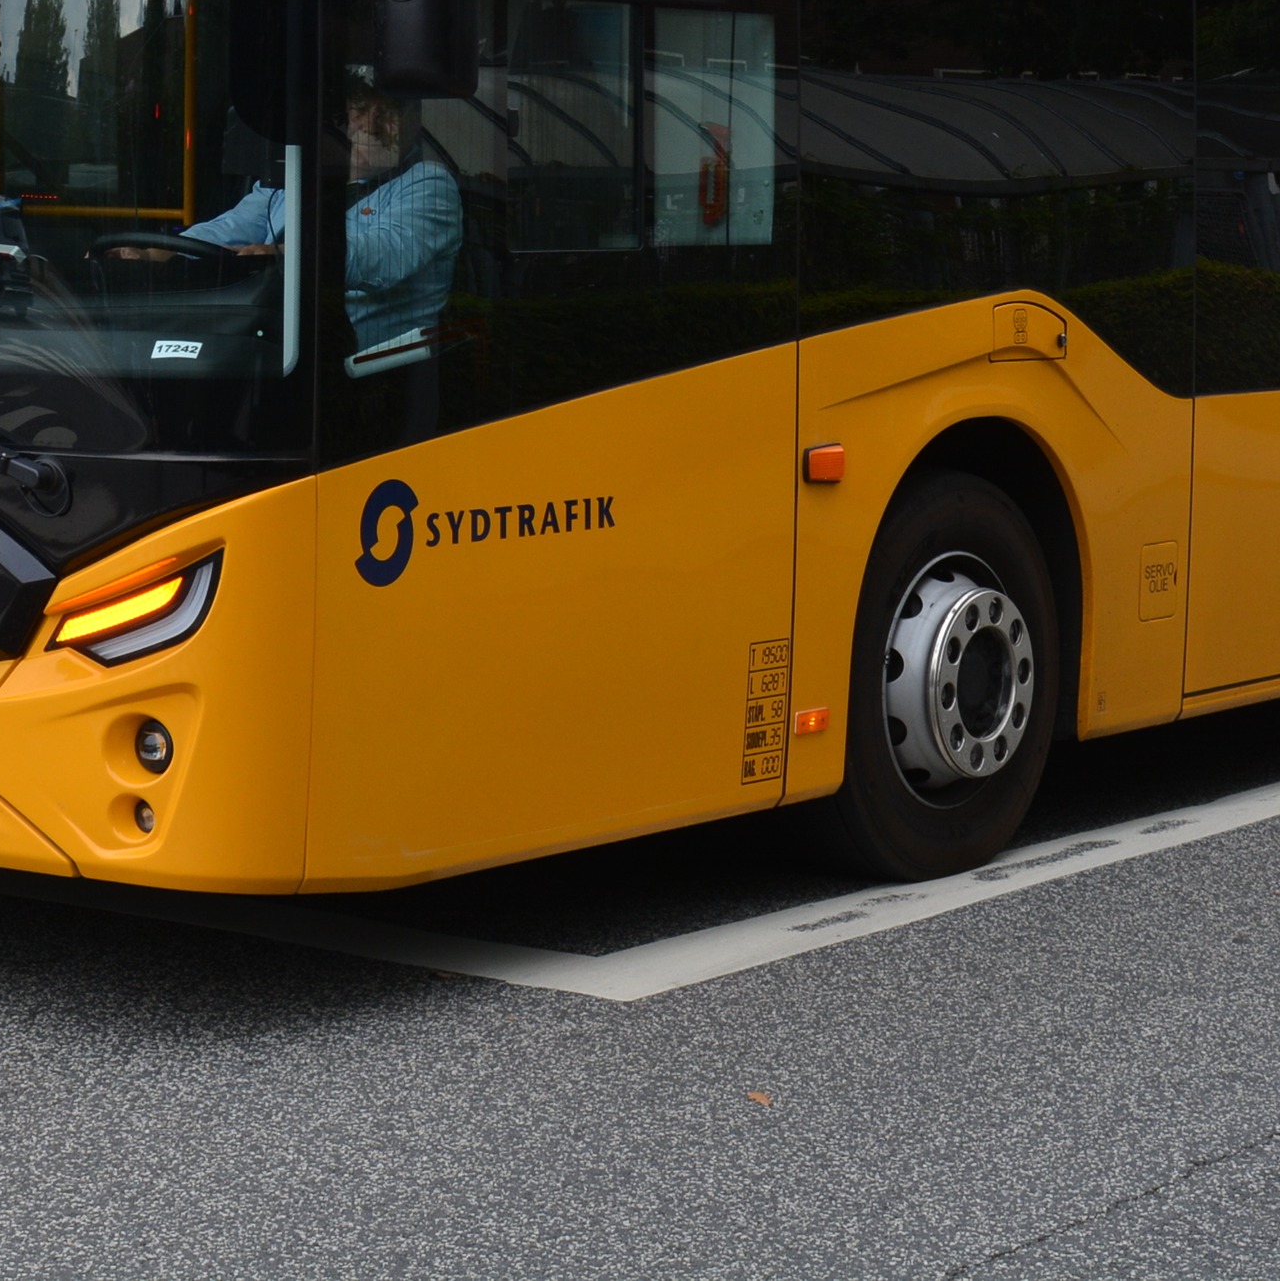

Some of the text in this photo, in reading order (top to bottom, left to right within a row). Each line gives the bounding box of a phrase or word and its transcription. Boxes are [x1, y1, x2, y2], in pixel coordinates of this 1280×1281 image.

[156, 344, 199, 354] 17242
[425, 495, 616, 547] SYDTRAFIK
[1144, 562, 1174, 579] SERVO
[1148, 578, 1168, 593] OLIE
[761, 644, 788, 664] 19500
[761, 672, 785, 692] 6287
[771, 699, 783, 718] 58
[770, 727, 782, 746] 35
